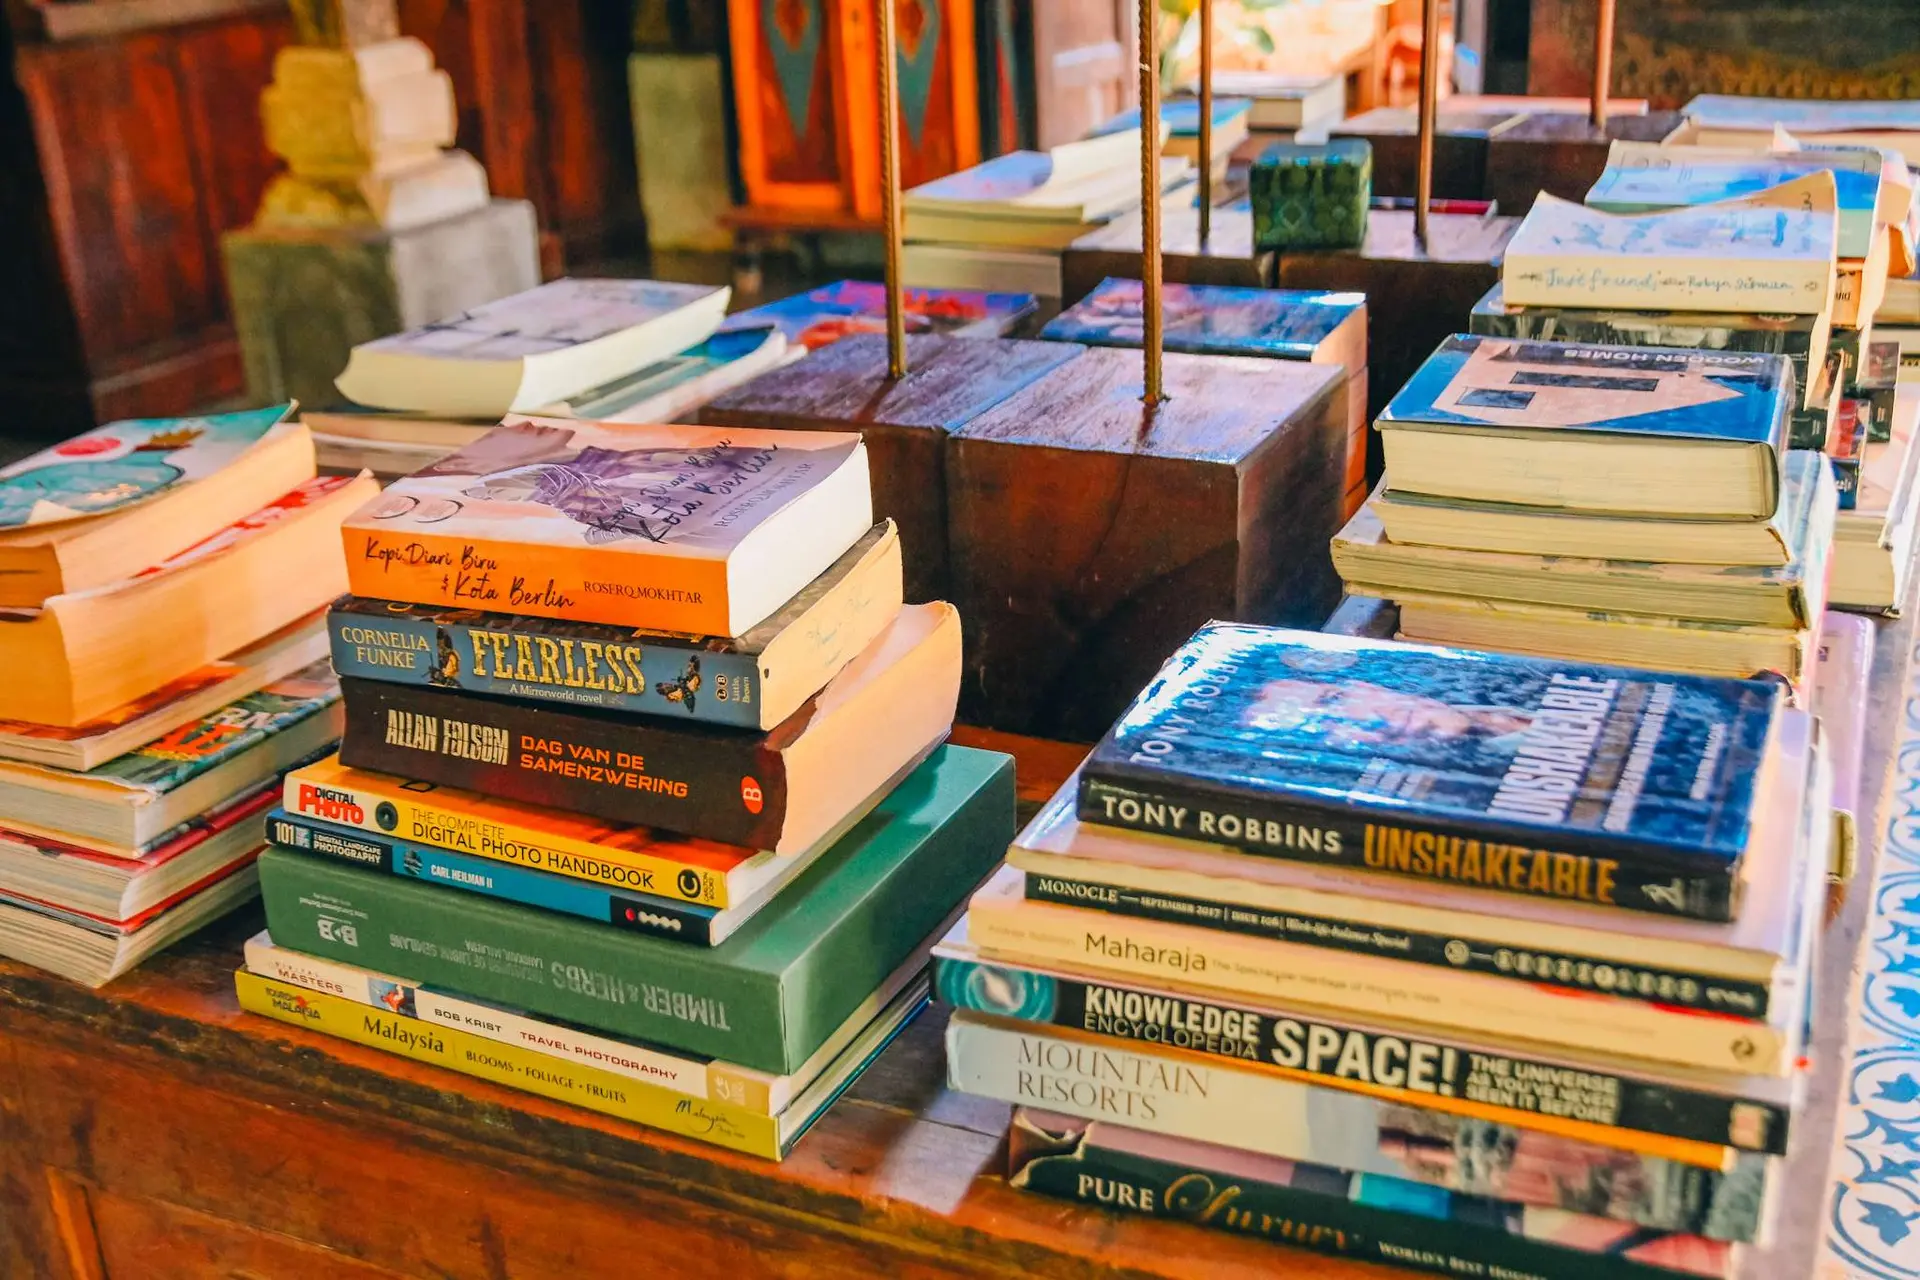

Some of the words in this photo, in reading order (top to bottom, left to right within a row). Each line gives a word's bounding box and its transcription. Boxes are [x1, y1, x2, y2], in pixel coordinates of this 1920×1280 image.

[1563, 348, 1648, 361] HOMES
[1655, 353, 1765, 365] WOODEN
[405, 543, 452, 566] Diari
[461, 545, 498, 571] Biru
[454, 571, 499, 601] Kota
[509, 575, 575, 608] Berlin
[636, 585, 703, 604] MOKHTAR
[341, 626, 431, 651] CORNELIA
[356, 646, 416, 669] FUNKE
[468, 629, 646, 696] FEARLESS
[509, 683, 519, 694] A
[519, 684, 575, 702] Mirrorworld
[575, 691, 603, 704] novel
[385, 709, 438, 752] ALLAN
[442, 718, 510, 766] FOLSOM
[520, 735, 563, 756] DAG
[568, 743, 611, 765] VAN
[616, 752, 645, 771] DE
[1128, 714, 1198, 765] TONY
[1486, 673, 1619, 823] UNSHAKEABLE
[520, 753, 689, 798] SAMENZWERING
[299, 783, 365, 826] PHOTO
[314, 787, 356, 806] DIGITAL
[274, 821, 295, 845] 101
[410, 807, 434, 825] THE
[442, 814, 505, 842] COMPLETE
[313, 840, 381, 864] PHOTOGRAPHY
[343, 839, 382, 856] LANDSCAPE
[413, 822, 476, 850] DIGITAL
[482, 838, 542, 864] PHOTO
[547, 851, 655, 890] HANDBOOK
[1102, 795, 1188, 830] TONY
[1199, 810, 1343, 854] ROBBINS
[1364, 823, 1620, 906] UNSHAKEABLE
[431, 863, 450, 880] CARL
[452, 867, 485, 888] HEILMAN
[486, 877, 493, 889] II
[1038, 878, 1119, 904] MONOCLE
[1140, 896, 1194, 914] SEPTEMBER
[1085, 932, 1207, 973] Maharaja
[277, 968, 344, 994] MASTERS
[551, 961, 626, 1005] HERBS
[643, 983, 731, 1031] TIMBER
[1084, 984, 1262, 1043] KNOWLEDGE
[434, 1008, 460, 1023] BOB
[465, 1016, 503, 1033] KRIST
[520, 1030, 569, 1052] TRAVEL
[575, 1045, 678, 1081] PHOTOGRAPHY
[1084, 1012, 1260, 1061] ENCYCLOPEDIA
[363, 1015, 444, 1054] Malaysia
[466, 1049, 514, 1074] BLOOMS
[525, 1067, 575, 1090] FOLIAGE
[586, 1083, 627, 1104] FRUITS
[1017, 1036, 1211, 1099] MOUNTAIN
[1271, 1018, 1459, 1097] SPACE!
[1469, 1053, 1511, 1076] THE
[1514, 1062, 1619, 1095] UNIVERSE
[1017, 1070, 1159, 1121] RESORTS
[1077, 1172, 1156, 1213] PURE
